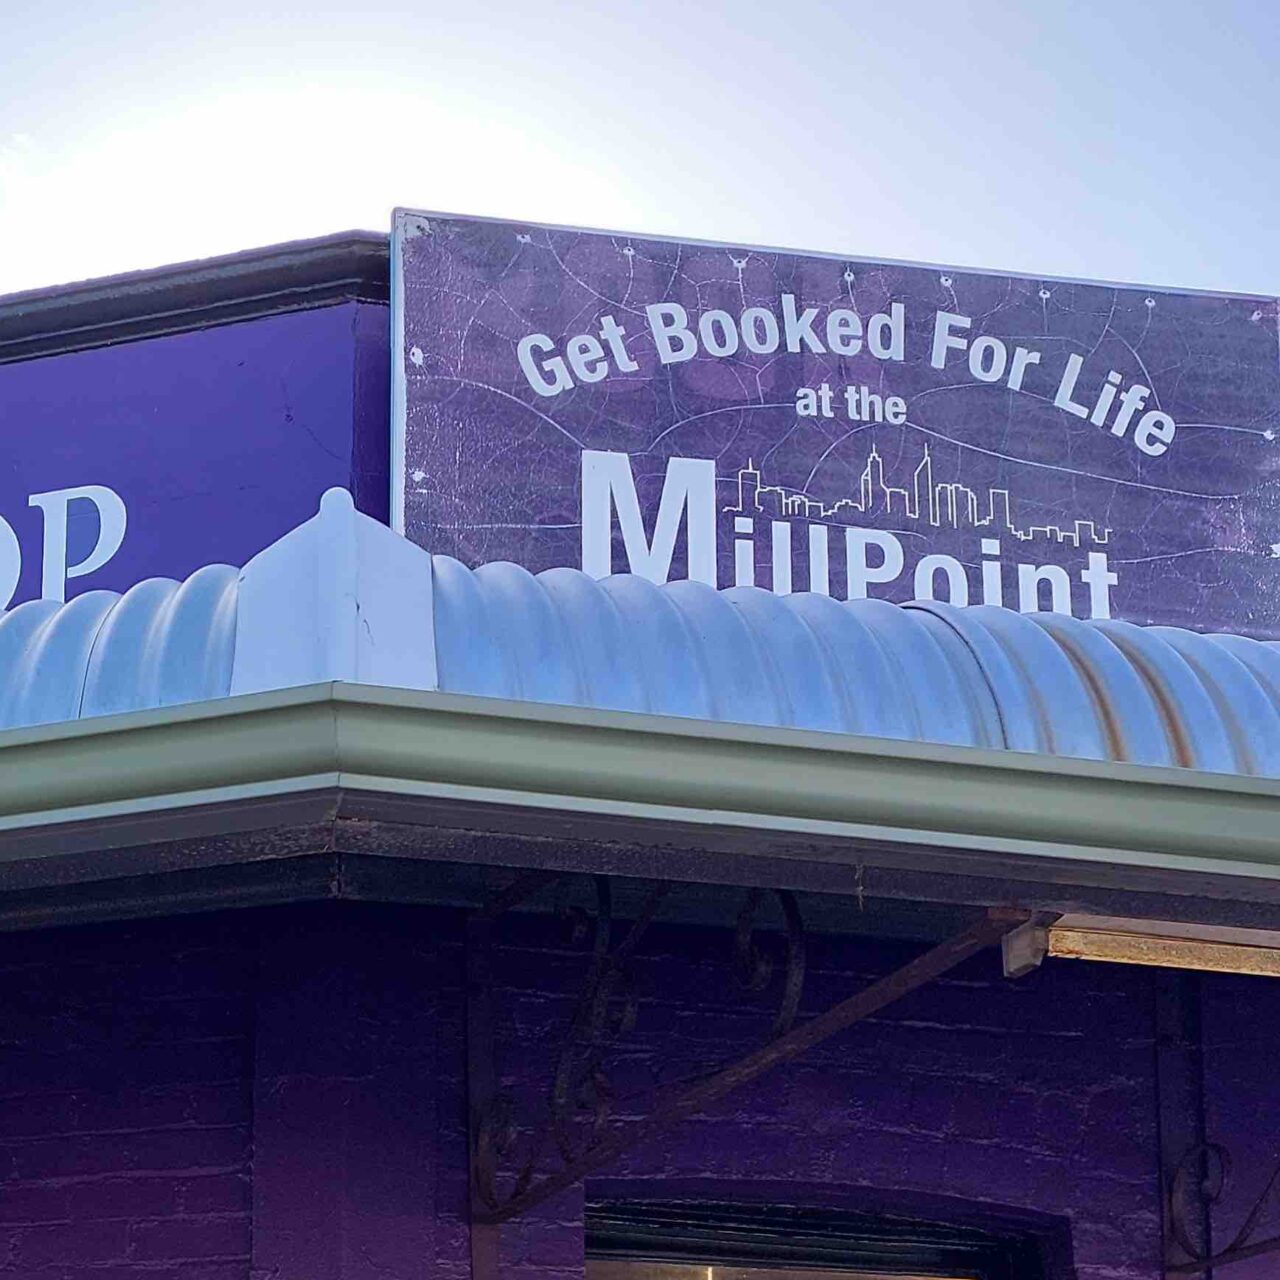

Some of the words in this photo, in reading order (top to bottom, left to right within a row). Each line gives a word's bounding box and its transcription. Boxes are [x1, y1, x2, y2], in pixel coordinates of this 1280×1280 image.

[516, 312, 641, 398] Get
[645, 293, 906, 366] Booked
[931, 309, 1042, 392] For
[1053, 354, 1178, 458] Life
[795, 385, 841, 418] at
[846, 384, 908, 425] the
[581, 449, 1118, 619] MillPoint
